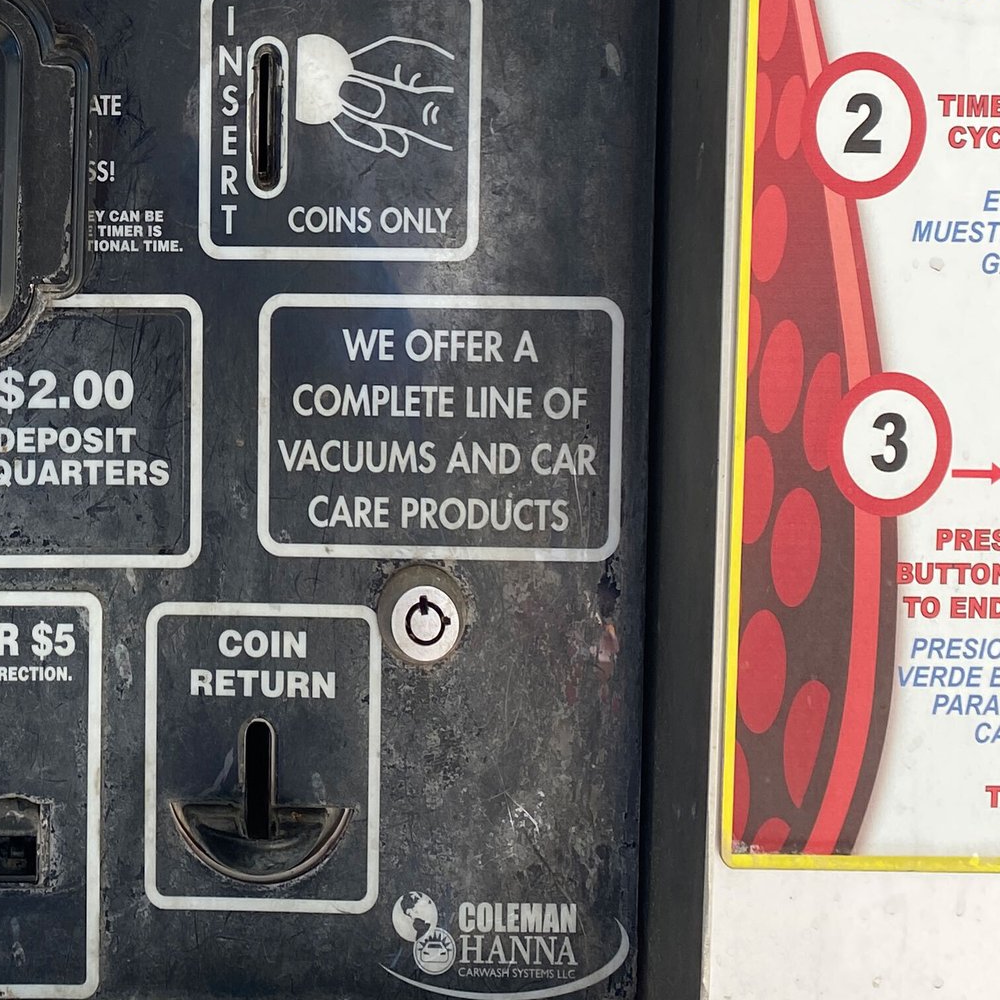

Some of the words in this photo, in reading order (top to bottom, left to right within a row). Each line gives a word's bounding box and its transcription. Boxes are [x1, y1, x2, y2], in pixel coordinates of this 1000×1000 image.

[218, 5, 243, 235] INSERT
[843, 92, 882, 154] 2
[98, 225, 143, 237] TIMER
[147, 226, 162, 237] IS
[109, 211, 140, 222] CAN
[145, 211, 164, 222] BE
[288, 206, 372, 235] COINS
[380, 206, 453, 234] ONLY
[143, 240, 183, 252] TIME.
[342, 329, 394, 361] WE
[405, 329, 503, 362] OFFER
[513, 330, 538, 363] A
[292, 384, 454, 418] COMPLETE
[466, 386, 532, 419] LINE
[543, 387, 588, 420] OF
[871, 412, 908, 472] 3
[277, 440, 436, 474] VACUUMS
[446, 441, 521, 475] AND
[531, 443, 597, 476] CAR
[308, 495, 389, 529] CARE
[400, 498, 569, 532] PRODUCTS
[903, 596, 940, 619] TO
[31, 621, 76, 660] $5
[218, 629, 307, 658] COIN
[190, 669, 336, 699] RETURN
[898, 665, 983, 687] VERDE
[932, 694, 1000, 715] PARA
[458, 902, 577, 934] COLEMAN
[459, 935, 578, 966] HANNA
[458, 967, 509, 978] CARWASH
[512, 967, 554, 979] SYSTEMS
[557, 969, 576, 980] LLC
